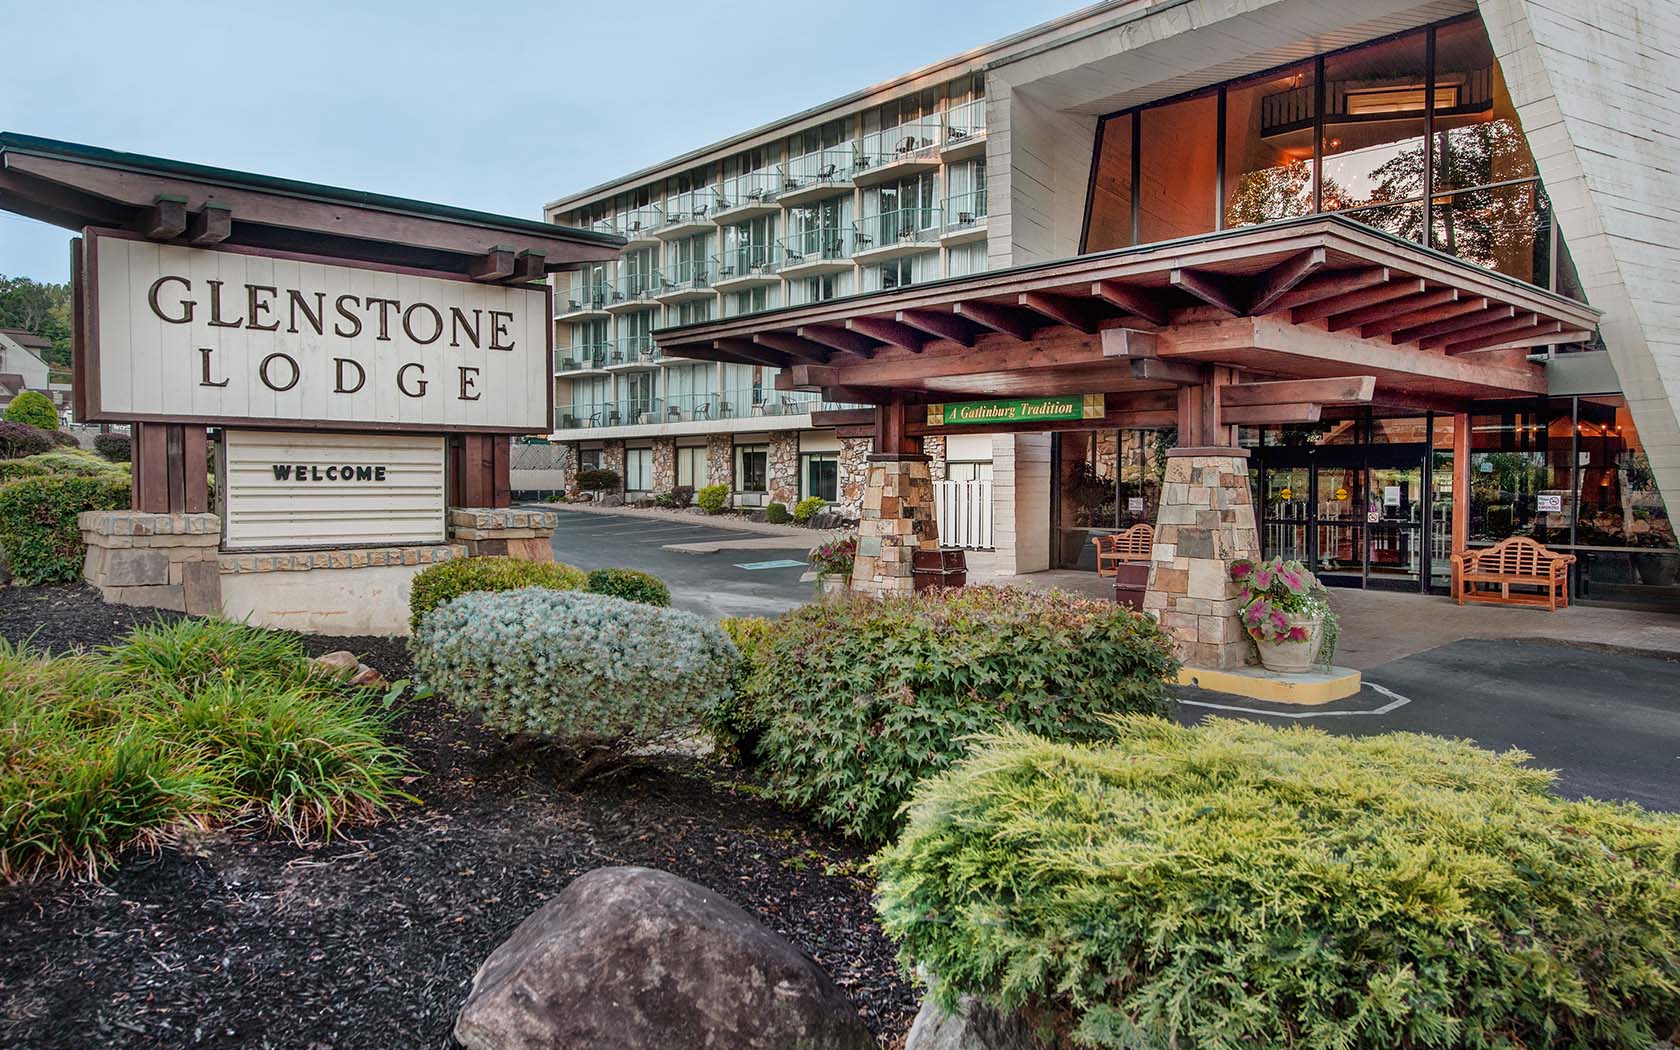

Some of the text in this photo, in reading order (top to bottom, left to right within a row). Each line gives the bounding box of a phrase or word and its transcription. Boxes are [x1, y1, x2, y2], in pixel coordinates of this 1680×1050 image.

[147, 275, 516, 352] GLENSTONE
[198, 347, 482, 401] LODGE
[949, 402, 1073, 419] A Gatlinburg Tradition
[272, 464, 386, 482] WELCOME
